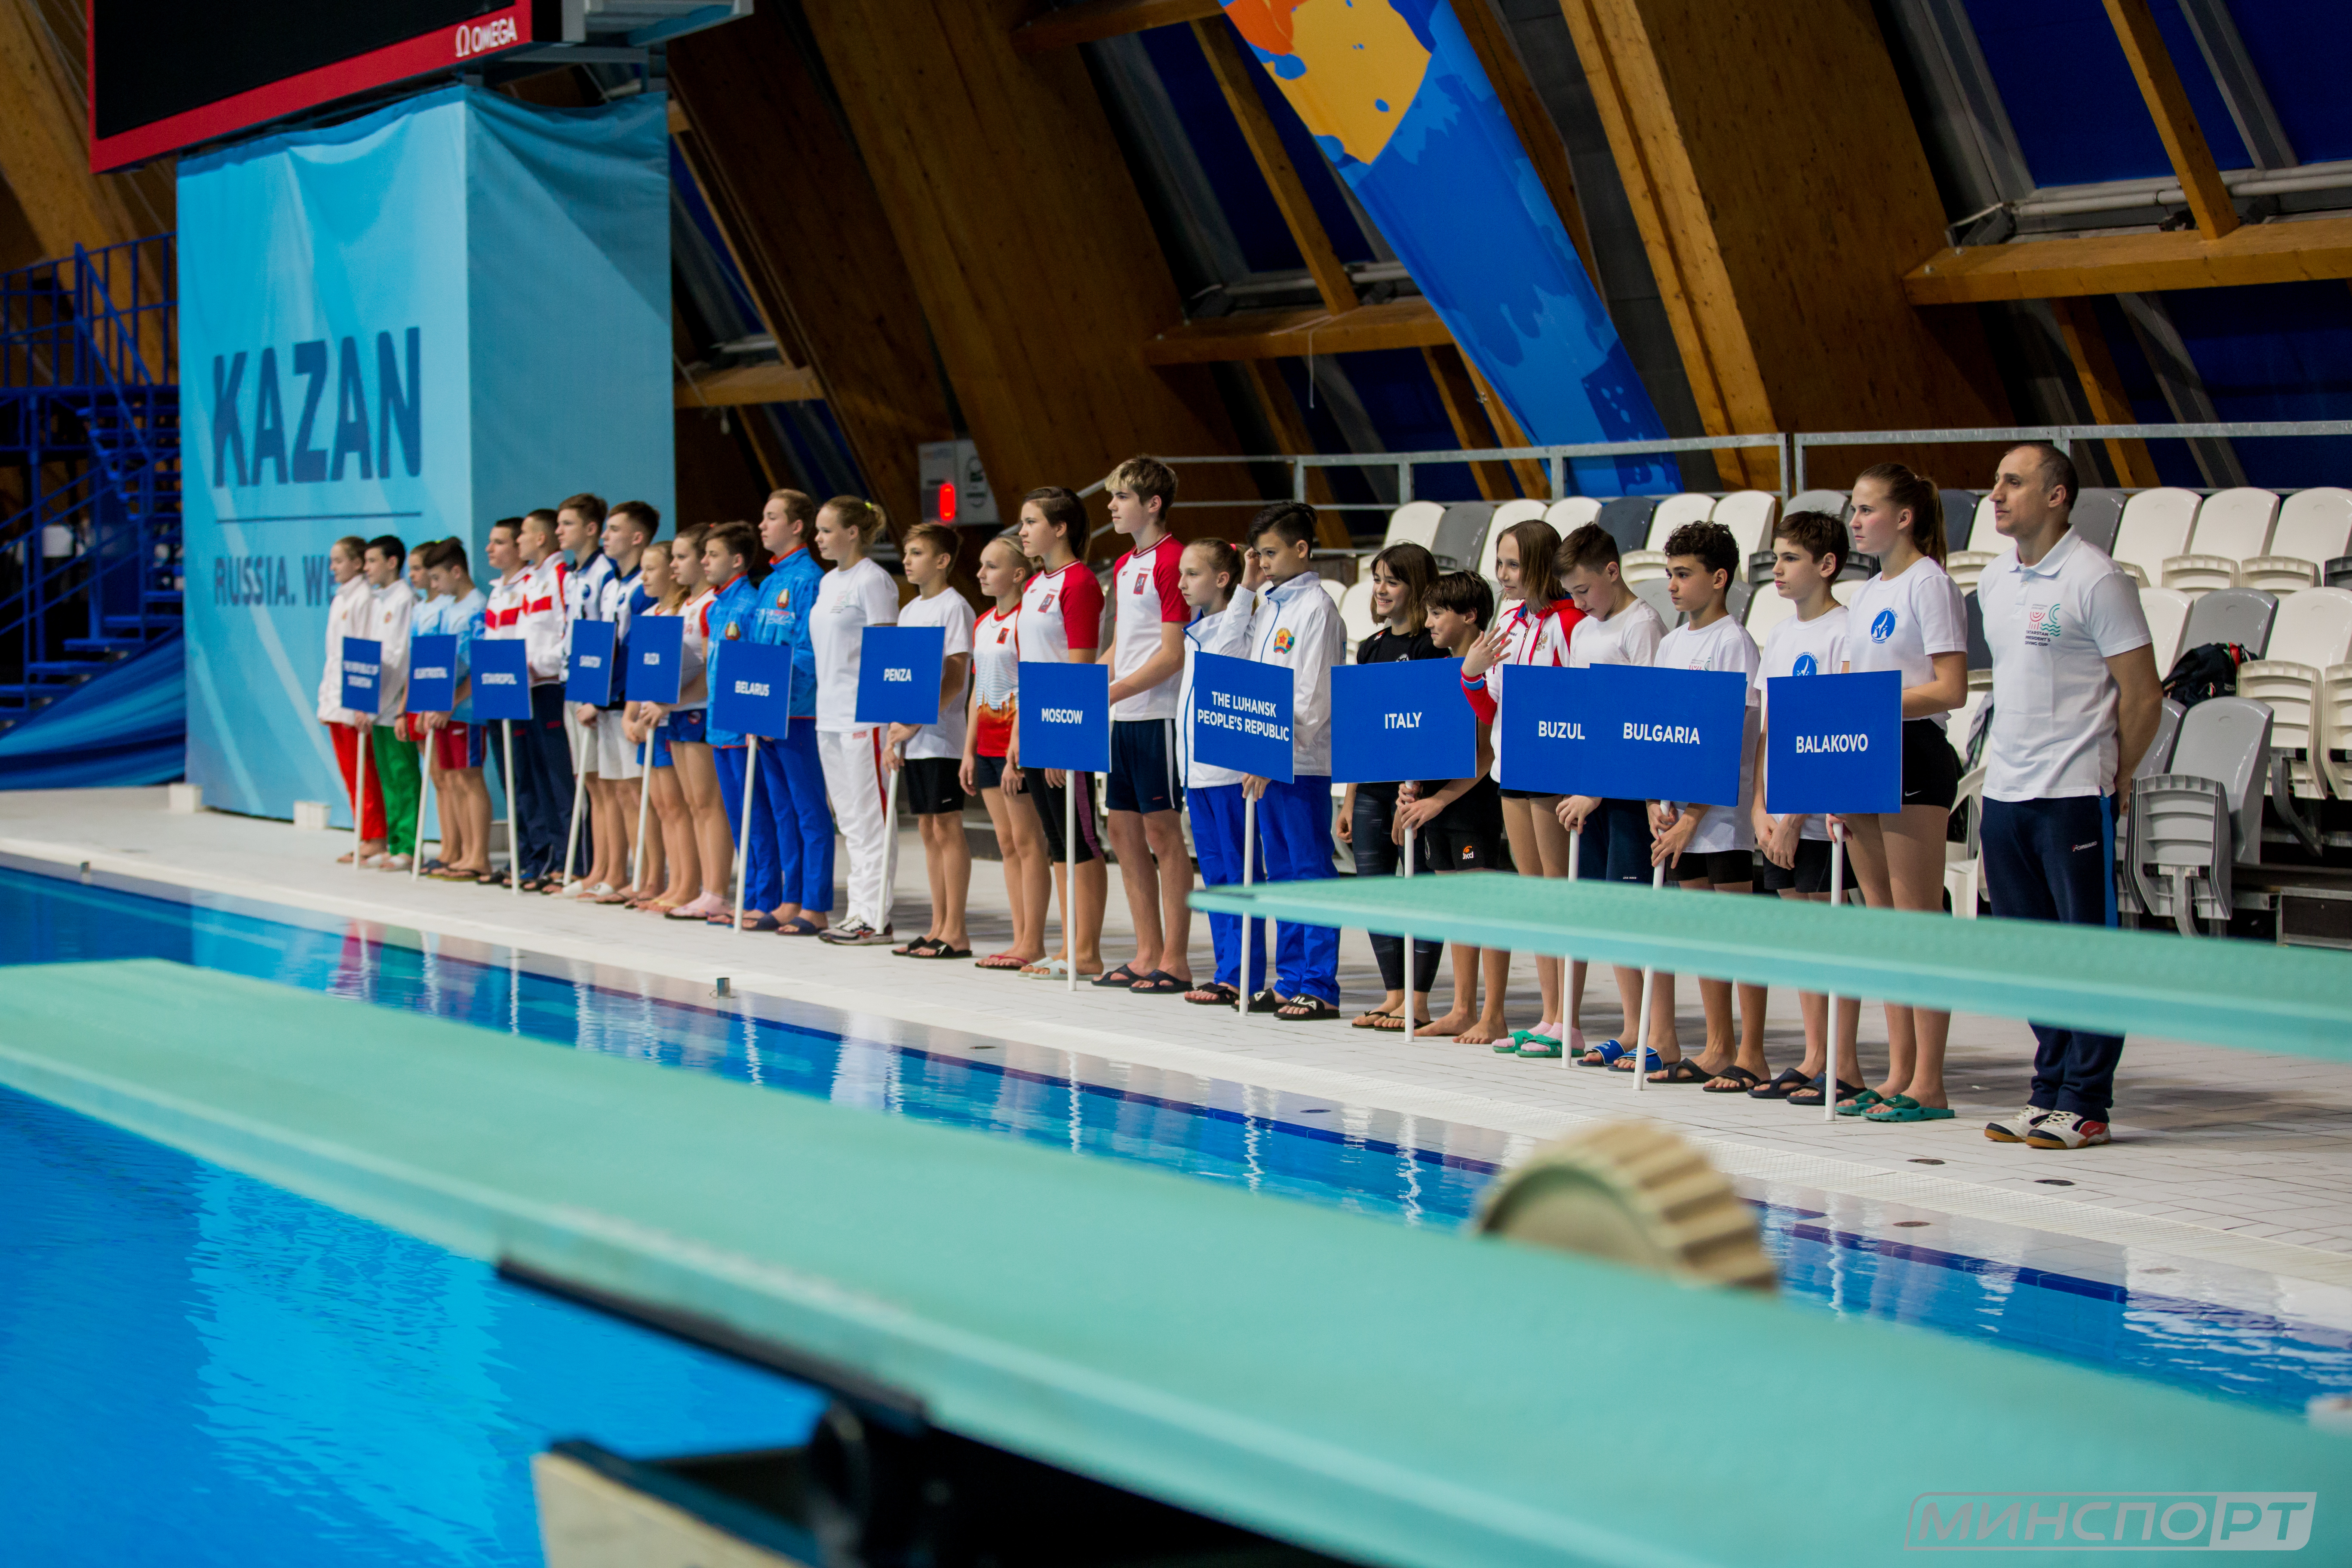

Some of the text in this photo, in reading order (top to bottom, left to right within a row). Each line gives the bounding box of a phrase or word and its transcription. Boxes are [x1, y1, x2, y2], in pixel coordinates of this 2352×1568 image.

[471, 16, 518, 52] OMEGA
[214, 326, 421, 488] KAZAN
[215, 555, 296, 607] RUSSIA.
[884, 668, 912, 681] PENZA
[734, 681, 770, 697] BELARUS
[1212, 691, 1276, 718] THE LUHANSK
[1041, 708, 1083, 724] MOSCOW
[1198, 709, 1289, 742] PEOPLE'S REPUBLIC
[1385, 712, 1422, 729] ITALY
[1538, 721, 1585, 740] BUZUL
[1623, 722, 1700, 744] BULGARIA
[1796, 733, 1868, 753] BALAKOVO
